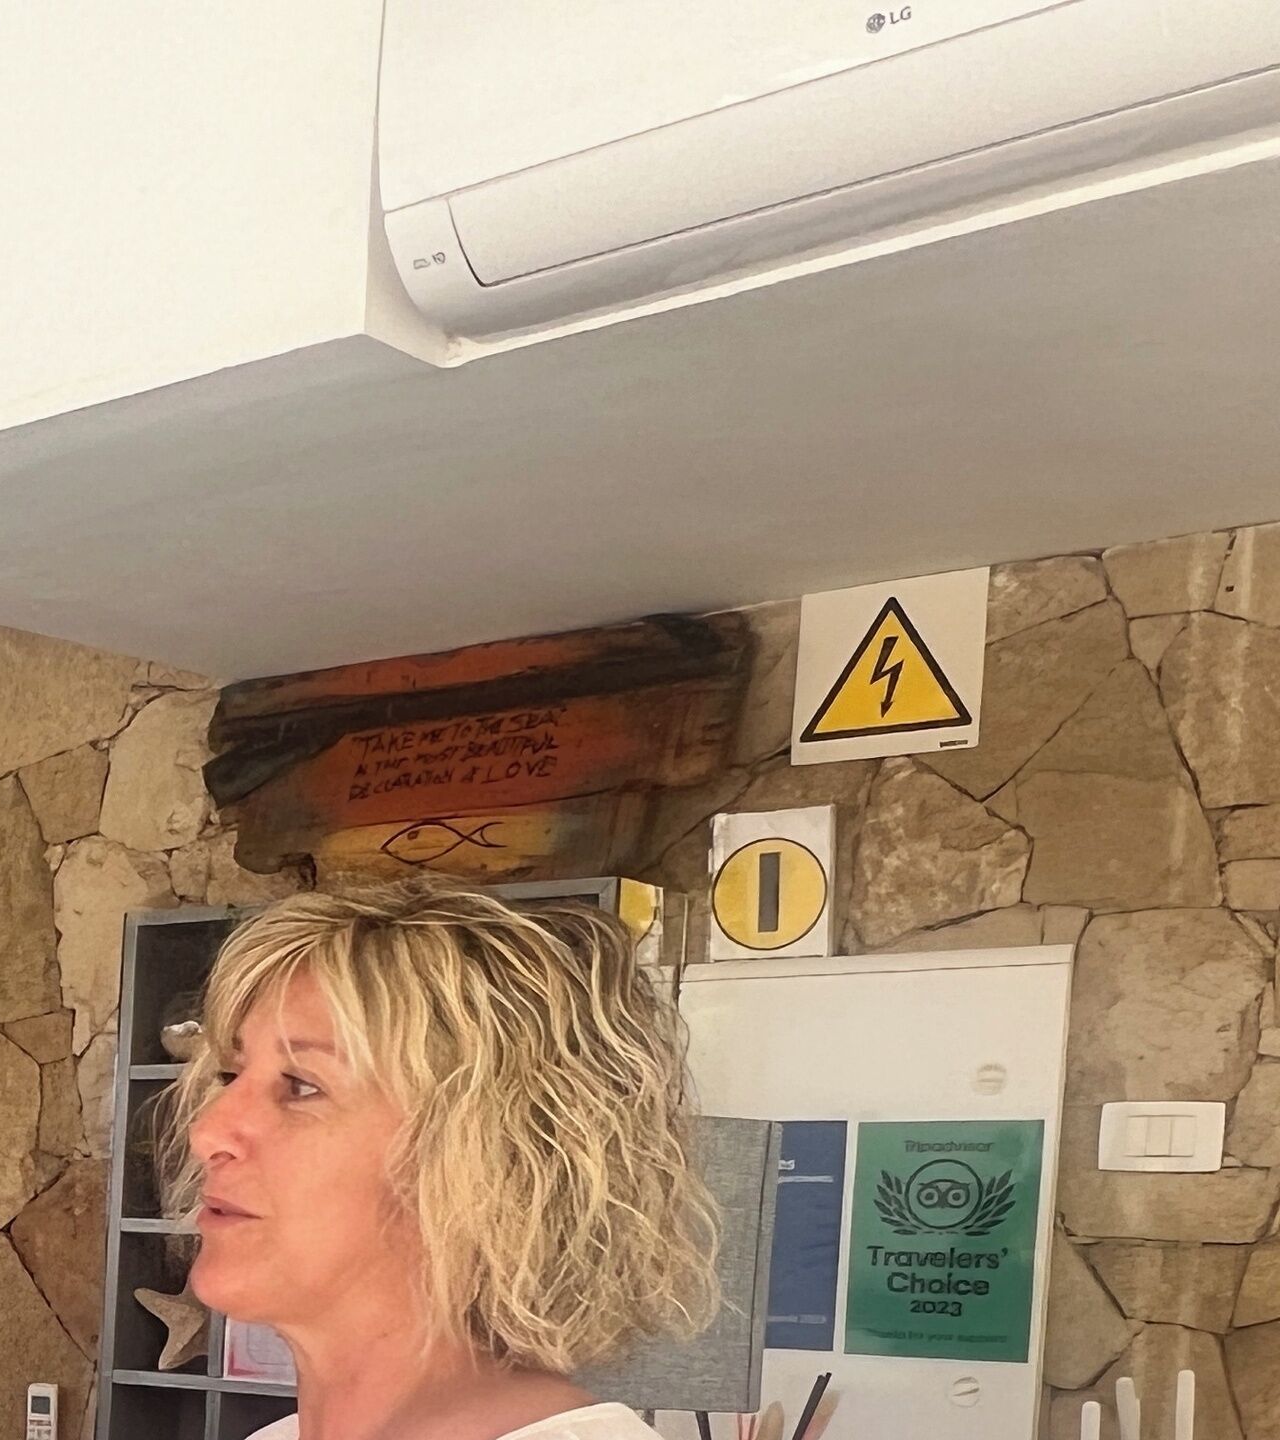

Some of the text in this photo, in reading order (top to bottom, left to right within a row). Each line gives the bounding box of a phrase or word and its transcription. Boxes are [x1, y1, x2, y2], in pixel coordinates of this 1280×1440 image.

[889, 6, 912, 25] LG
[449, 721, 472, 741] TO
[481, 755, 558, 784] LOVE
[886, 1272, 991, 1297] Choice
[909, 1299, 964, 1318] 2023
